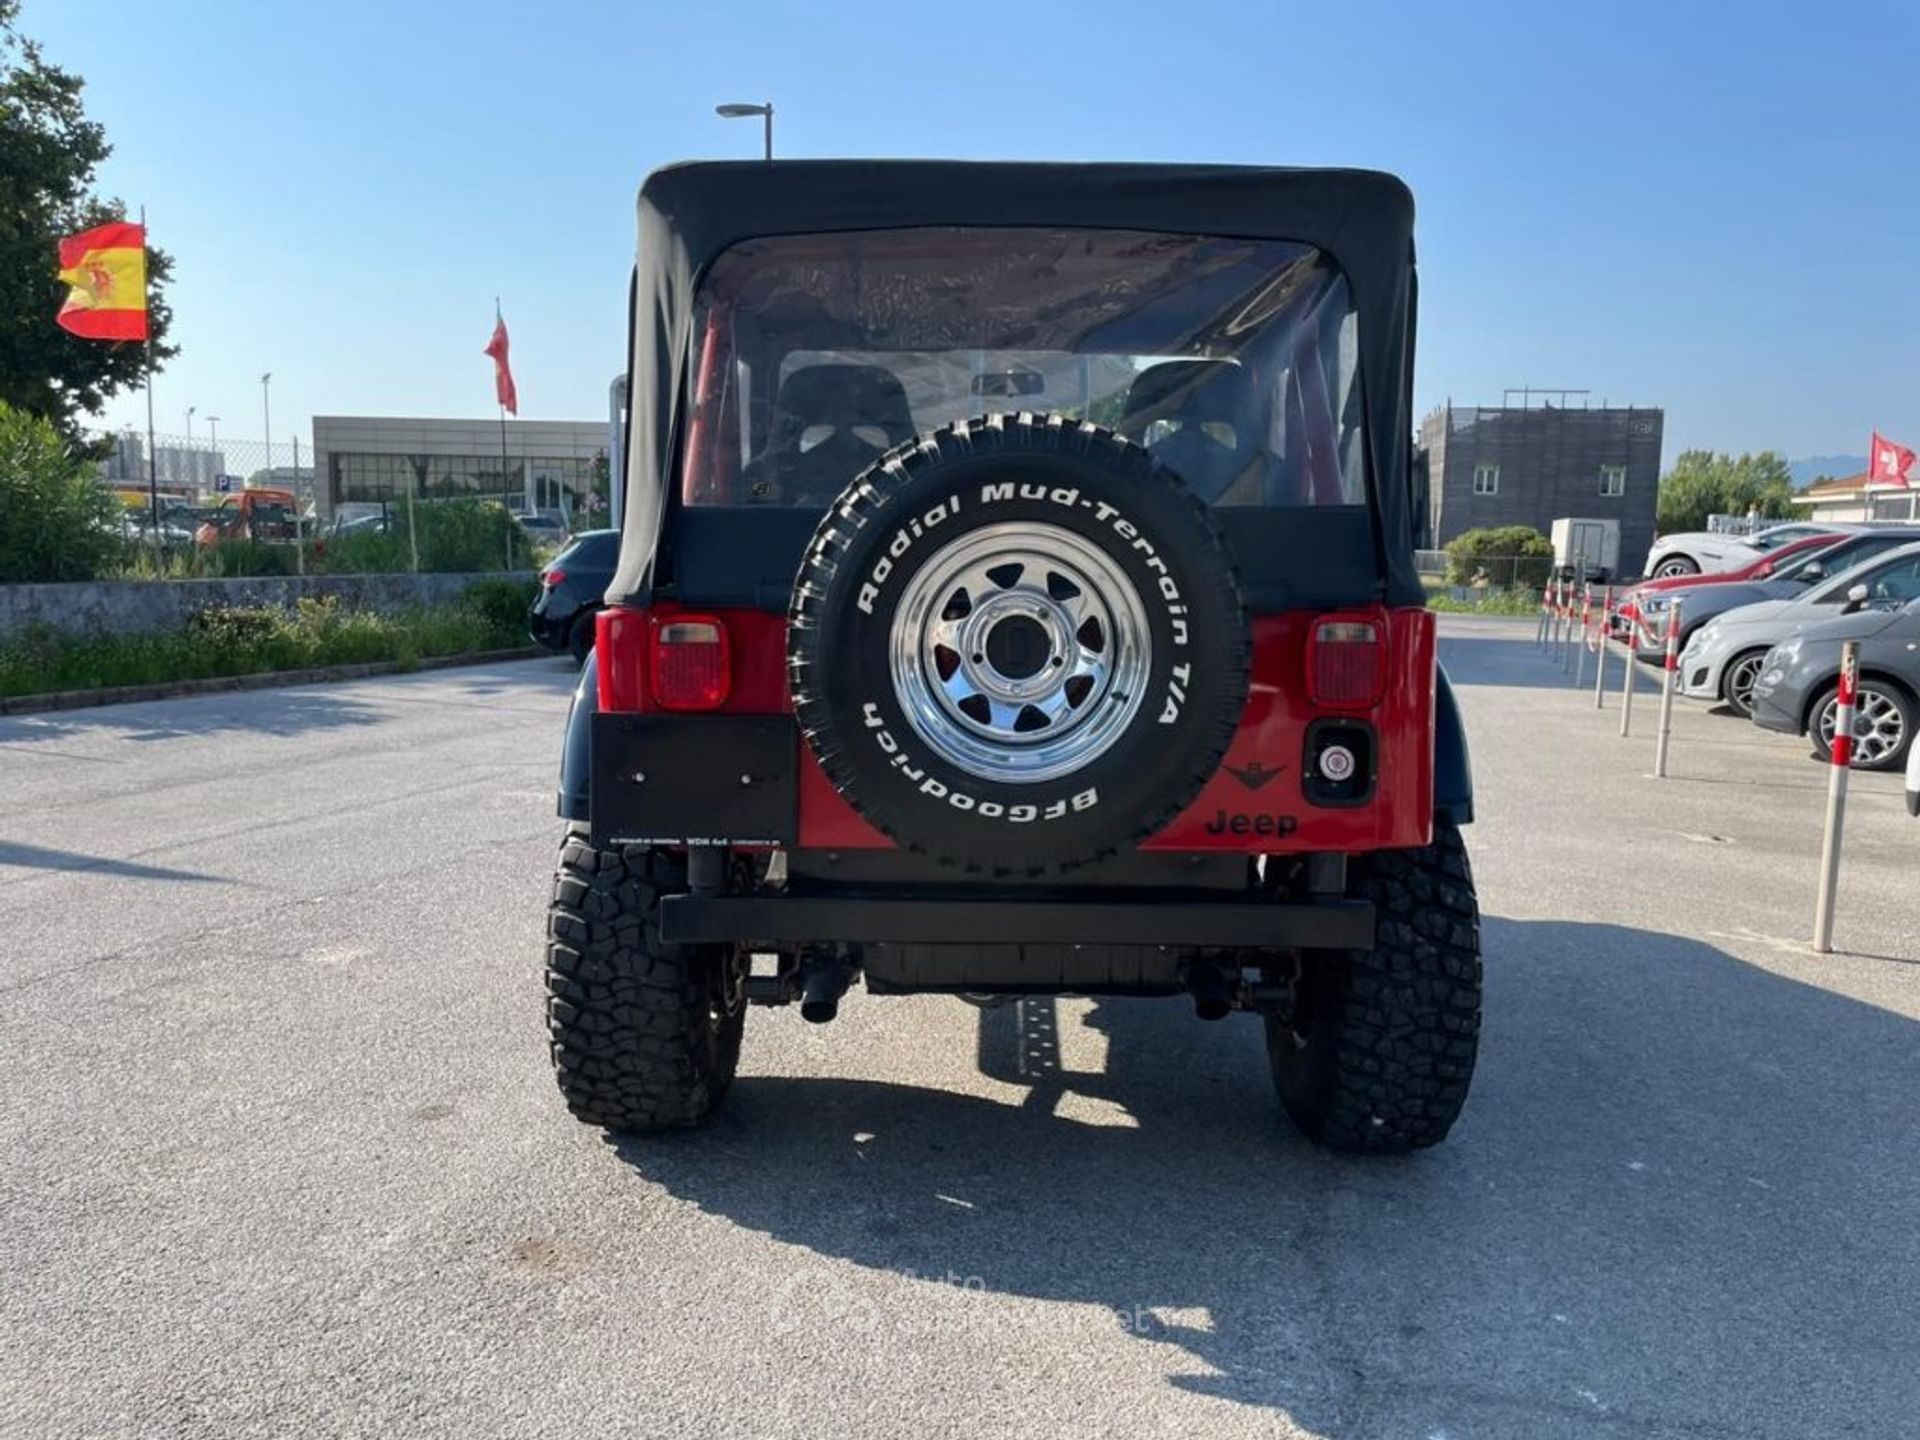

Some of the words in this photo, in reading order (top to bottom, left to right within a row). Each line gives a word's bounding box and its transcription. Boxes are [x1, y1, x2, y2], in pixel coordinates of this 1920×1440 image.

[857, 495, 960, 615] Radial
[981, 482, 1188, 645] Mud-Terrain
[1158, 662, 1191, 724] T/A
[863, 702, 1099, 823] BFGoodrich
[1206, 810, 1298, 838] Jeep
